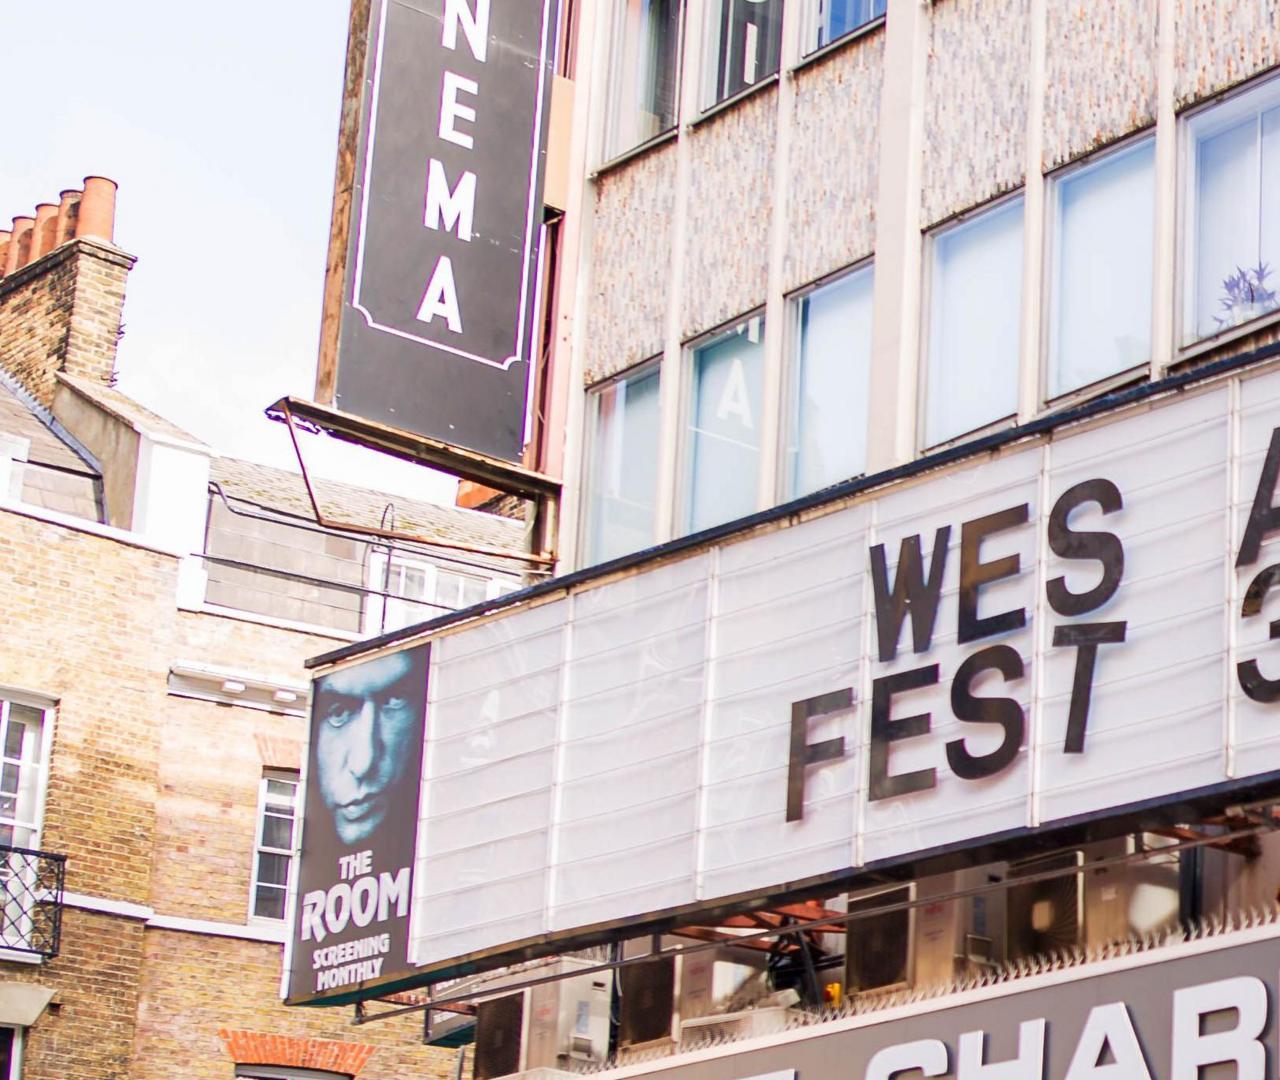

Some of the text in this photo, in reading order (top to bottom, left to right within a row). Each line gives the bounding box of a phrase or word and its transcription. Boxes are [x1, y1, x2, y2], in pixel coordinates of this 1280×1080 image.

[869, 478, 1127, 664] WES
[785, 620, 1128, 824] FEST
[338, 850, 374, 882] THE
[300, 867, 412, 944] ROOM
[312, 933, 391, 971] SCREENING
[316, 958, 385, 993] MONTHLY
